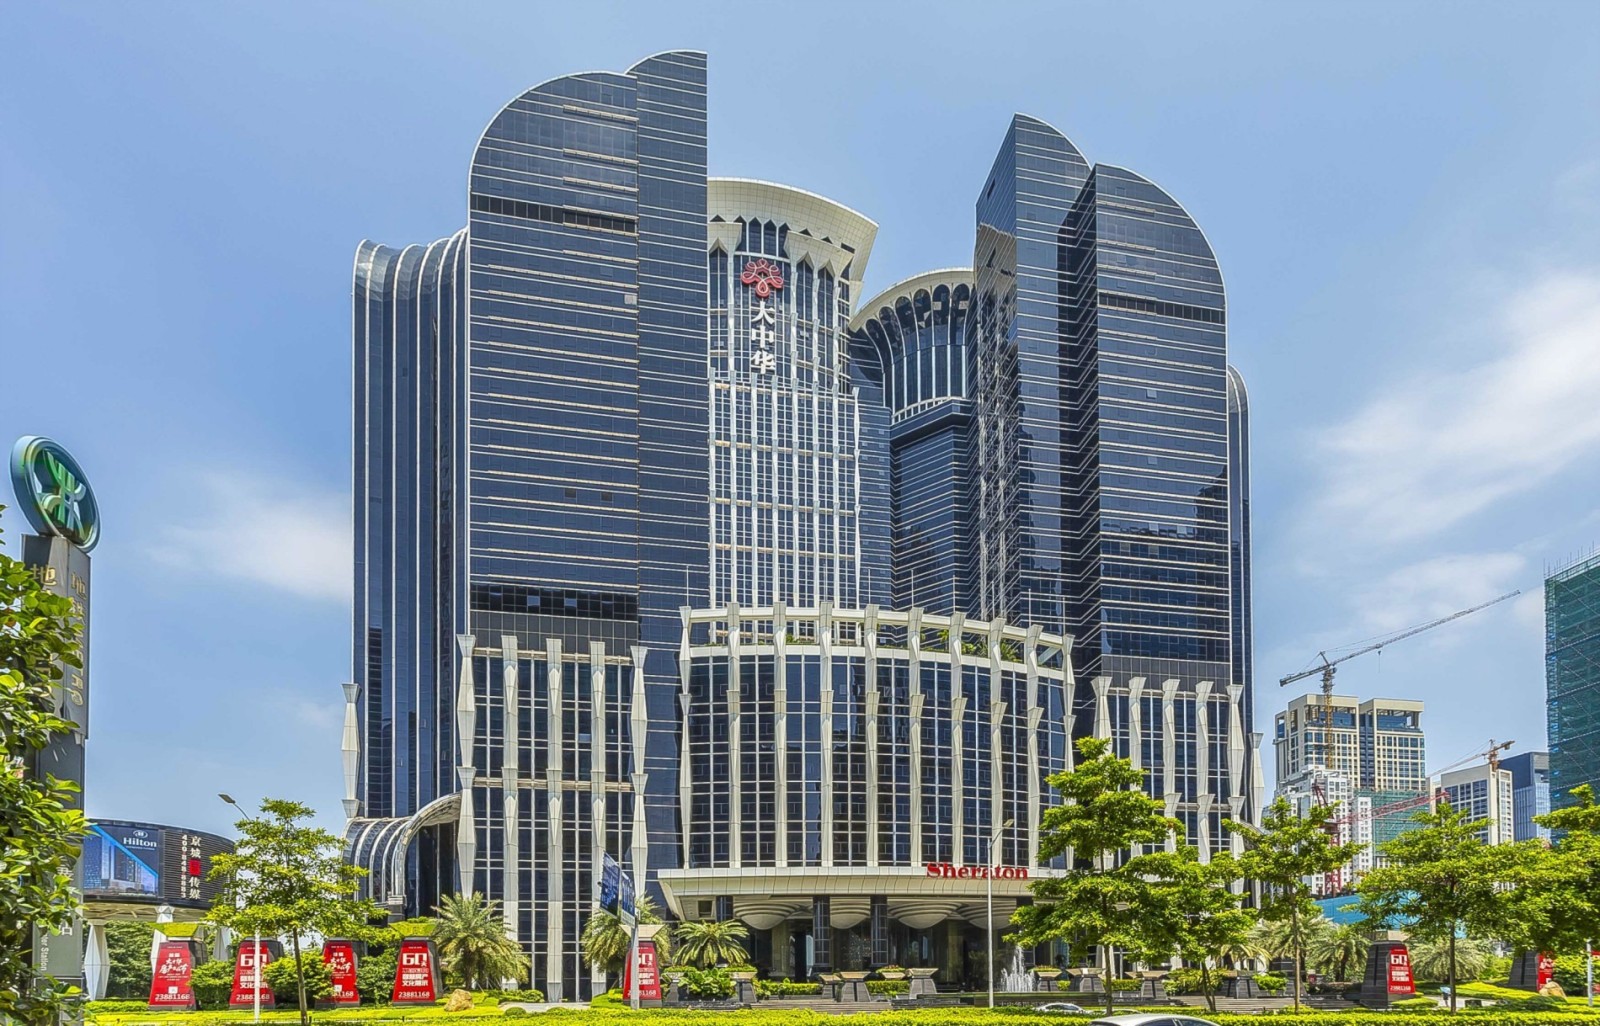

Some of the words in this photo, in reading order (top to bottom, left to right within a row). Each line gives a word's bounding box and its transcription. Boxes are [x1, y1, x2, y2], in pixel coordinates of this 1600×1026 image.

[751, 301, 776, 374] 大中华
[123, 837, 157, 848] Hilton
[926, 861, 1029, 880] Sheraton
